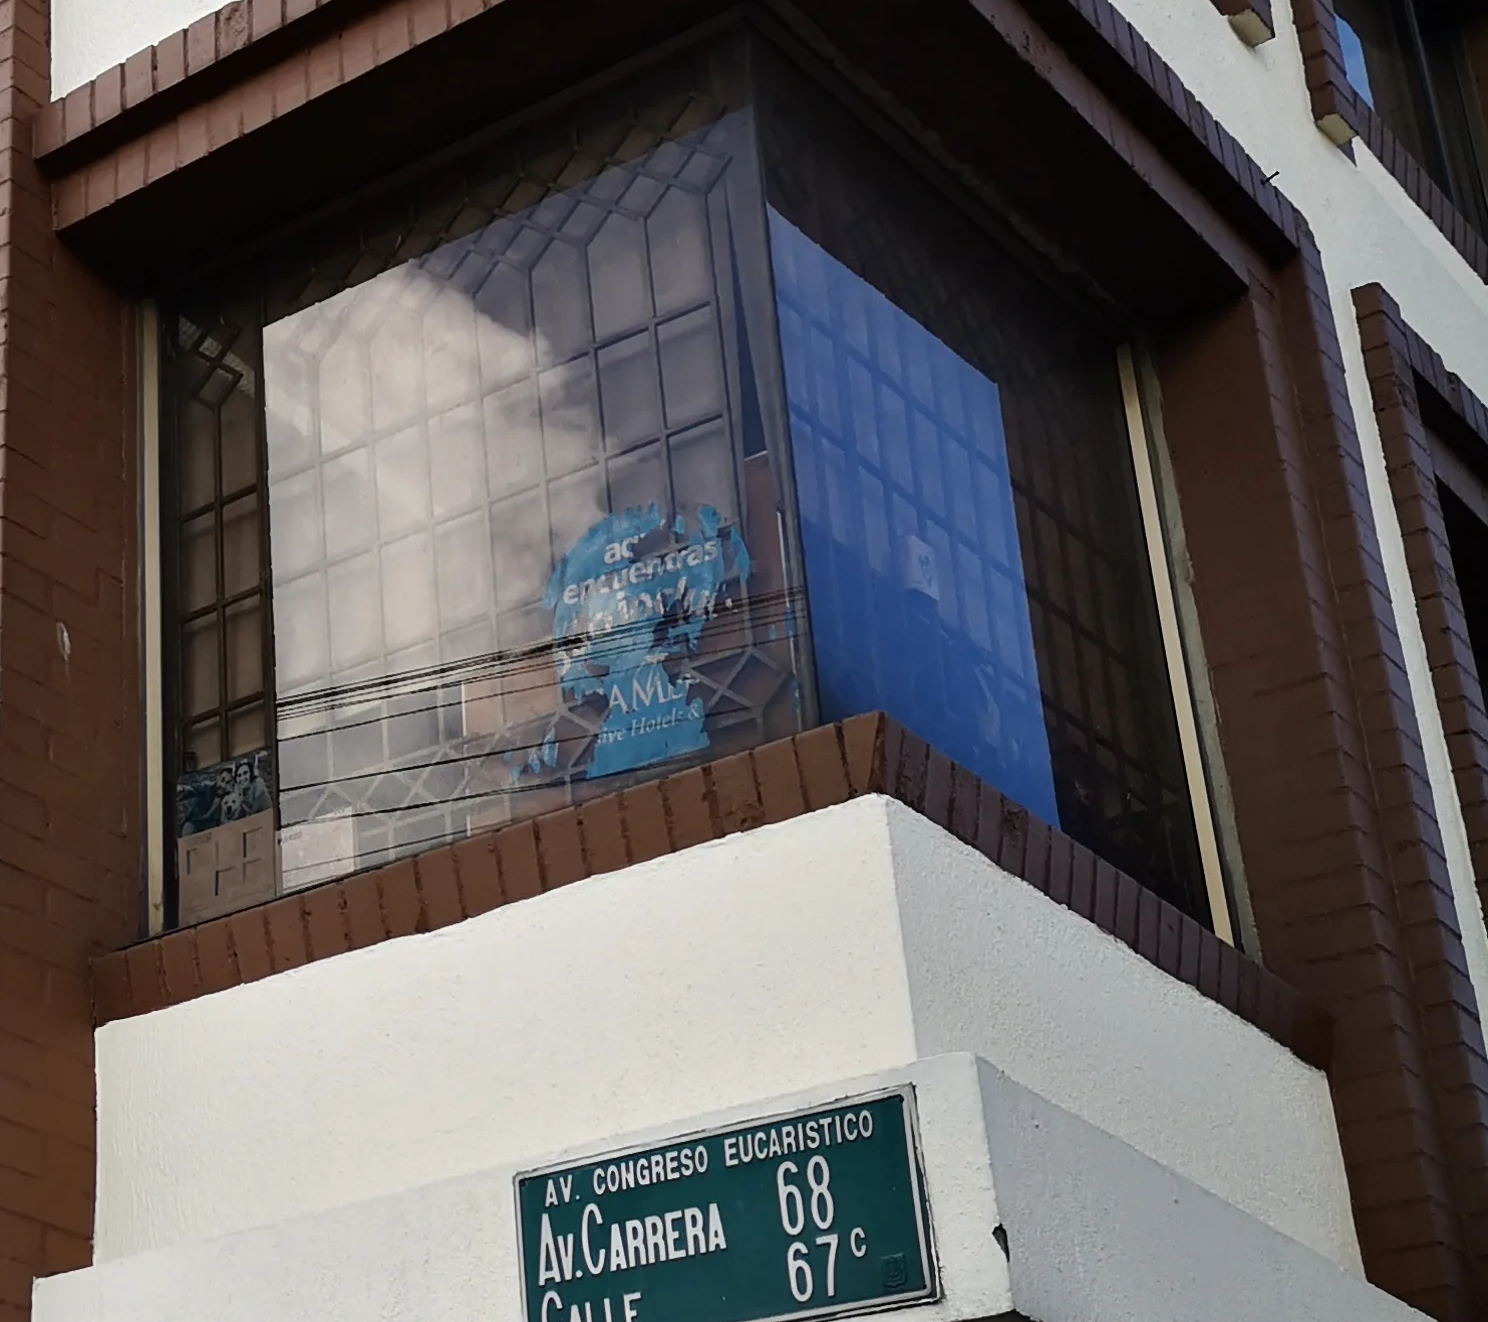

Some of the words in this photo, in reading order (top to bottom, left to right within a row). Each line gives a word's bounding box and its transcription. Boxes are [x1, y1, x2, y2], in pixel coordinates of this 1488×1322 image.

[545, 1174, 581, 1207] AV.
[593, 1144, 709, 1196] CONGRESO
[723, 1109, 874, 1168] EUCARISTICO
[776, 1155, 835, 1236] 68
[786, 1233, 839, 1303] 67
